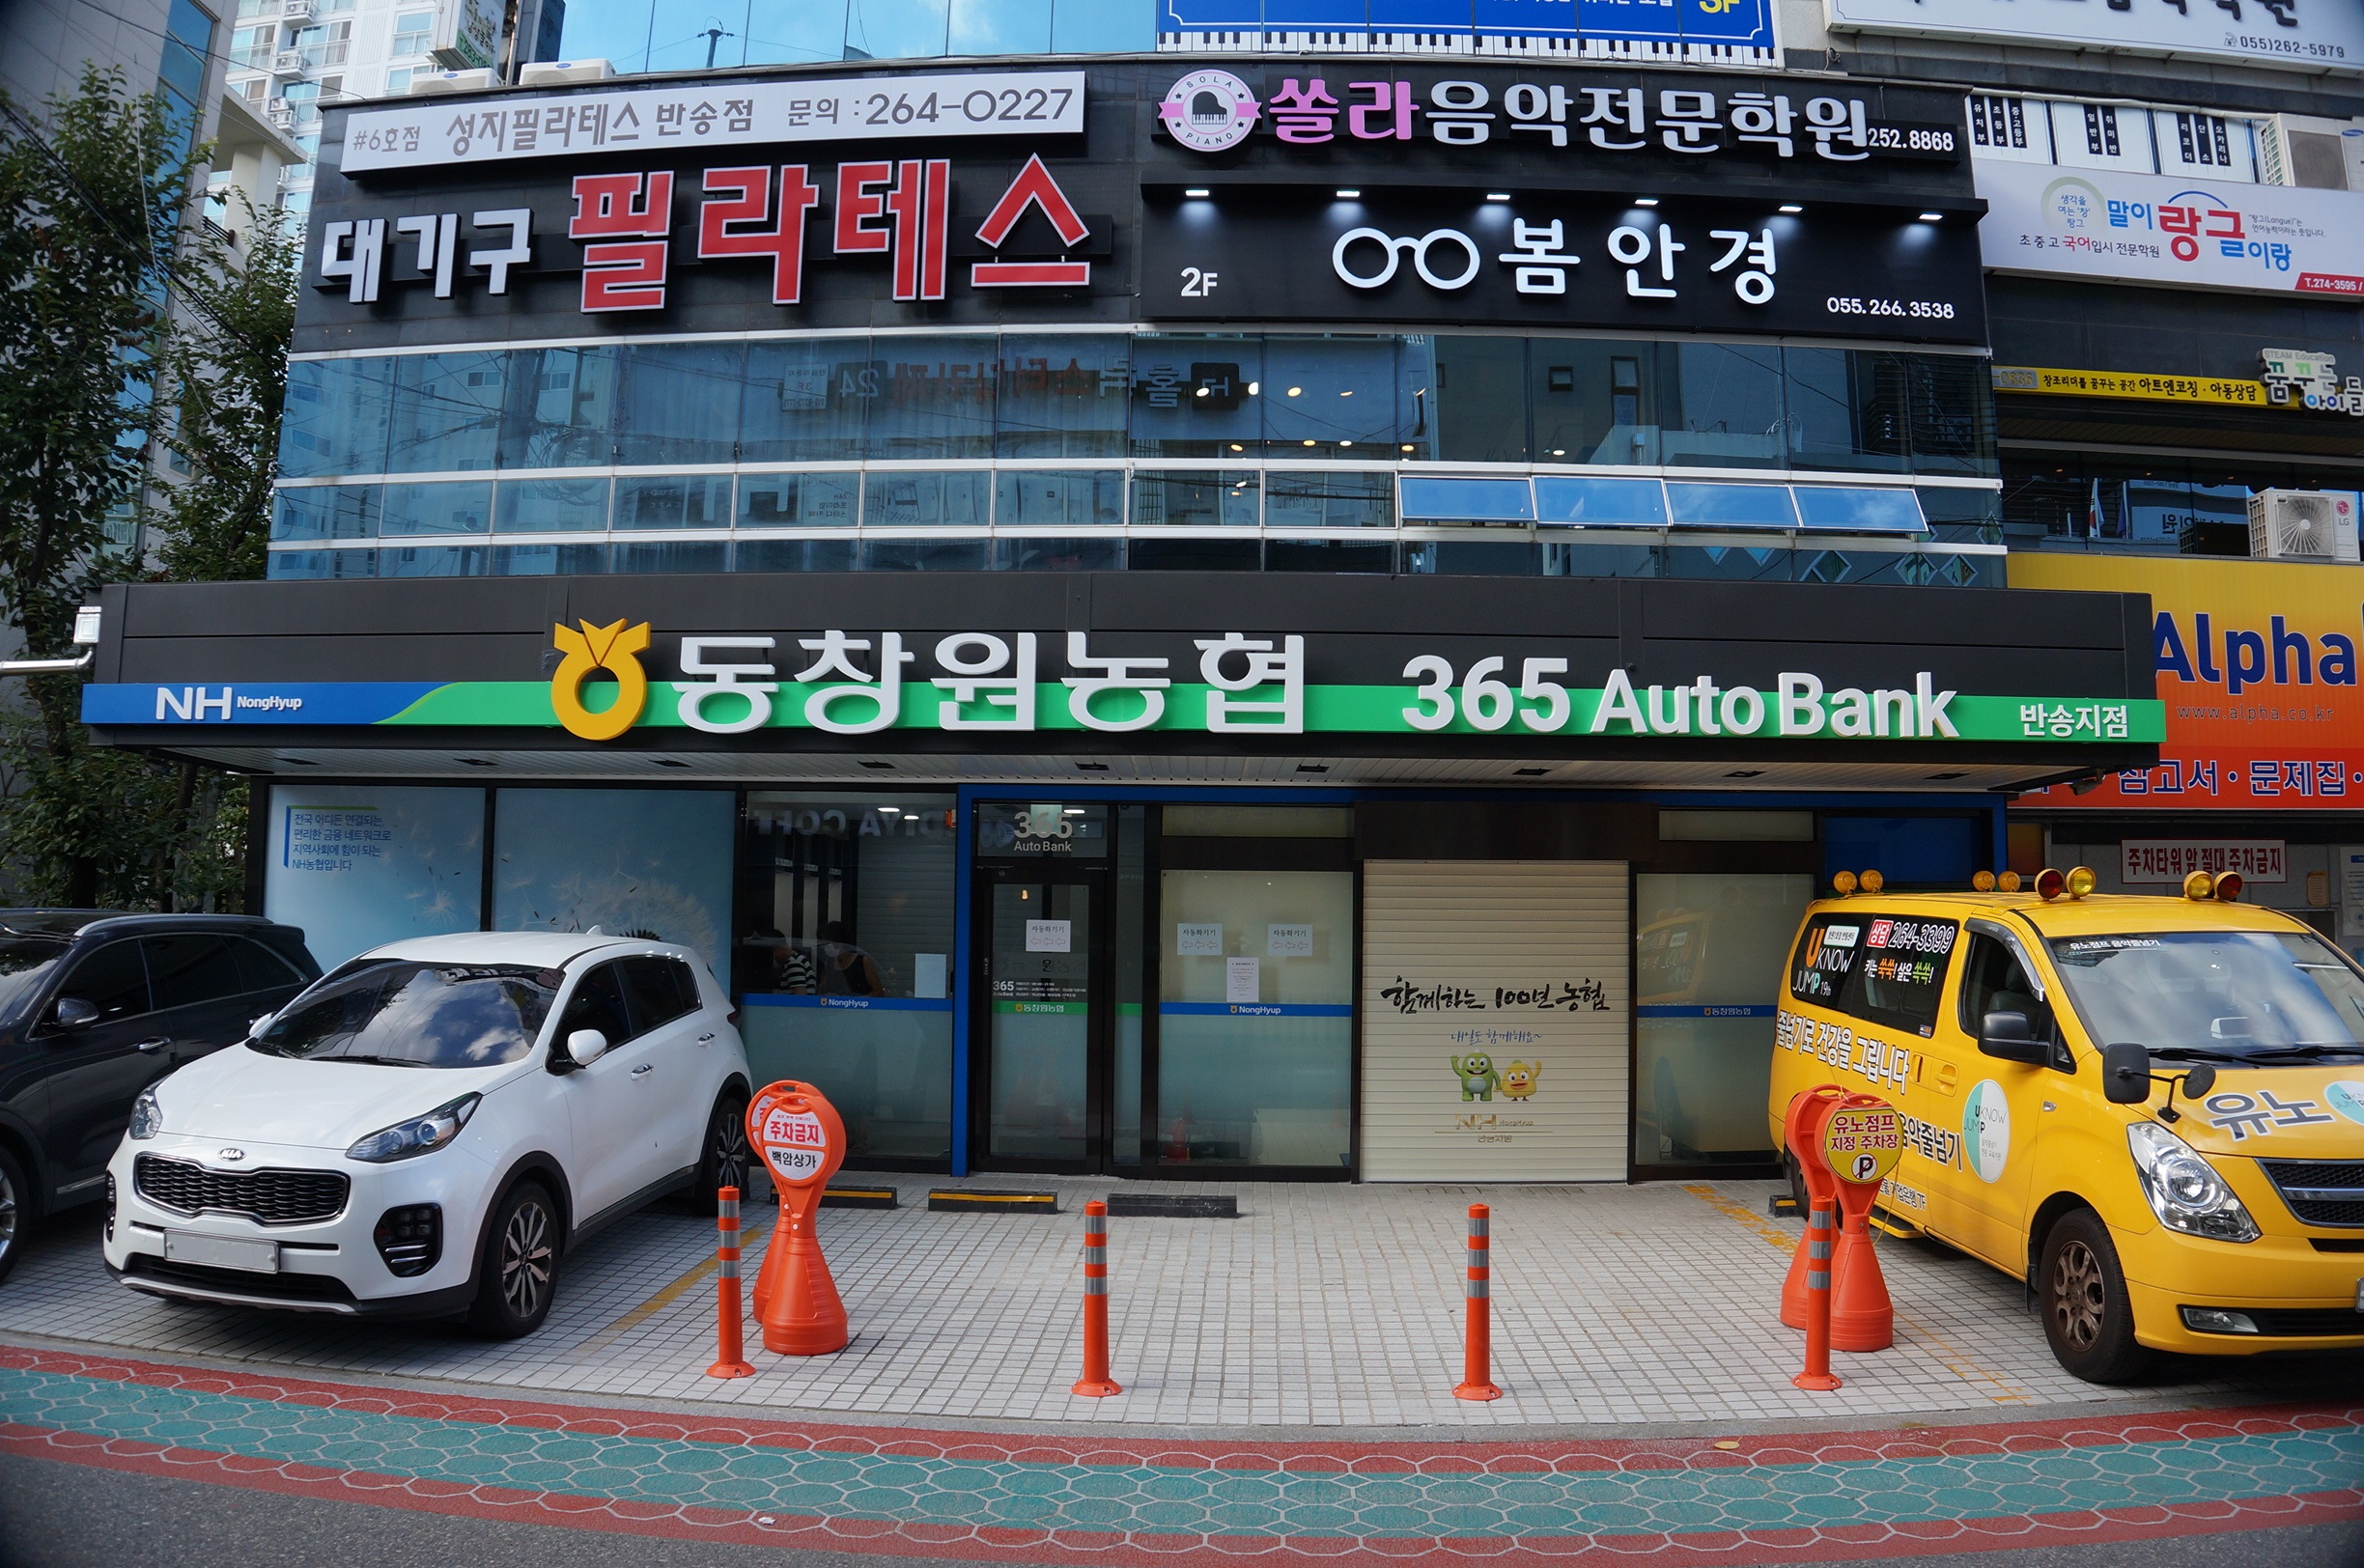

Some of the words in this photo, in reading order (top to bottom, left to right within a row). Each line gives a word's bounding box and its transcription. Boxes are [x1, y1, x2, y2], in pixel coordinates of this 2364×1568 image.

[2239, 35, 2346, 58] 055)262-5979
[1186, 75, 1232, 89] SOLA
[352, 124, 421, 153] #6호점
[446, 101, 640, 157] 성지필라테스
[657, 99, 754, 137] 반송점
[788, 98, 838, 126] 문의
[1973, 103, 1986, 144] 유치부
[1992, 105, 2006, 145] 초등부
[2105, 115, 2118, 154] 취미반
[1186, 131, 1233, 145] PIANO
[1867, 126, 1955, 153] 252.8868
[2180, 123, 2193, 161] 리코더
[2215, 125, 2229, 164] 오카리나
[2058, 206, 2075, 216] 여는
[2061, 194, 2087, 206] 생각을
[569, 153, 1090, 313] 필라테스
[2067, 218, 2085, 228] 랑그
[322, 209, 532, 304] 대기구
[1498, 218, 1777, 305] 봄안경
[2116, 242, 2160, 259] 전문학원
[1180, 268, 1218, 297] 2F
[2304, 276, 2356, 291] T.274-3595
[2265, 350, 2293, 360] STEAM
[2295, 351, 2334, 363] Education
[2043, 375, 2087, 390] 창조리더를
[2091, 378, 2116, 391] 꿈꾸는
[2120, 380, 2136, 392] 공간
[2209, 382, 2257, 402] 아동상담
[2266, 361, 2336, 400] 꿈꾸는
[2306, 378, 2364, 413] 아이들
[2338, 517, 2350, 527] LG
[2153, 610, 2358, 696] Alpha
[671, 630, 1305, 734] 동창원농협
[1401, 655, 1571, 734] 365
[1590, 669, 1765, 737] Auto
[1779, 671, 1959, 740] Bank
[2020, 703, 2128, 739] 반송지점
[155, 686, 232, 720] NH
[237, 694, 302, 712] NongHyup
[2177, 704, 2335, 724] www.alpha.co.kr
[2249, 761, 2347, 797] 문제집
[295, 814, 314, 826] 전국
[315, 814, 343, 826] 어디든
[345, 814, 383, 826] 연결되는
[1014, 811, 1073, 839] 365
[294, 829, 322, 841] 편리한
[324, 829, 342, 841] 금융
[344, 829, 391, 841] 네트워크로
[1014, 840, 1041, 852] Auto
[1042, 840, 1072, 852] Bank
[293, 844, 339, 855] 지역사회에
[341, 845, 360, 856] 힘이
[361, 846, 381, 857] 되는
[2229, 847, 2282, 876] 주차금지
[292, 859, 352, 871] NH농협입니다
[1031, 925, 1064, 934] 자동화기기
[1869, 921, 1891, 945] 상담
[1888, 921, 1956, 955] 264-3399
[993, 981, 1014, 992] 365
[1792, 970, 1821, 994] JUMP
[828, 997, 869, 1009] NongHyup
[1381, 975, 1486, 1015] 함께하는
[1494, 983, 1555, 1010] 100년
[1557, 977, 1611, 1012] 농협
[1239, 1006, 1281, 1015] NongHyup
[1712, 1007, 1751, 1016] 동창원농협
[1777, 1010, 1815, 1054] 줄넘기로
[1816, 1022, 1852, 1071] 건강을
[1852, 1037, 1910, 1096] 그립니다
[1455, 1113, 1496, 1130] NH
[1834, 1113, 1896, 1134] 유노점프
[2205, 1090, 2335, 1140] 유노
[770, 1121, 819, 1144] 주차금지
[1831, 1135, 1855, 1151] 지정
[1860, 1133, 1899, 1149] 주차장
[220, 1149, 242, 1159] KIA
[772, 1150, 817, 1168] 백암상가
